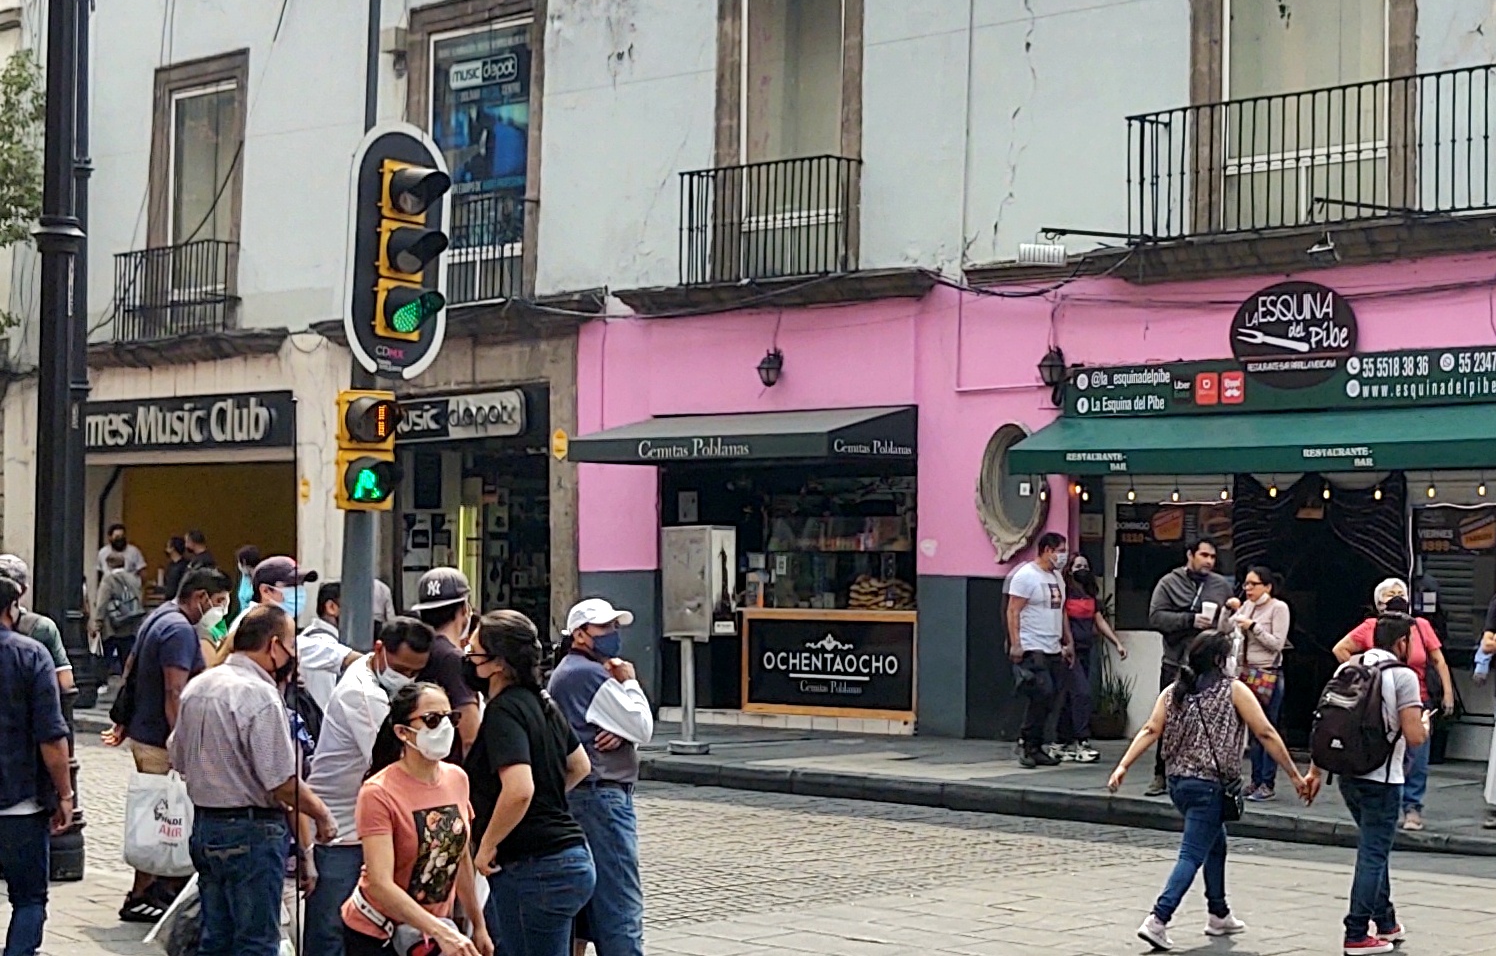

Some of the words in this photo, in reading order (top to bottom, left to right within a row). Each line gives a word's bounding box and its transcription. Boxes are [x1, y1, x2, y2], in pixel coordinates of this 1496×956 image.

[452, 67, 480, 83] music
[483, 57, 515, 79] depot
[1245, 312, 1258, 326] LA
[1258, 292, 1333, 322] ESQUINA
[1288, 322, 1306, 338] del
[1308, 321, 1349, 348] Pibe
[1362, 358, 1375, 378] 55
[1376, 357, 1400, 377] 5518
[1402, 357, 1414, 376] 38
[1416, 355, 1429, 375] 36
[1458, 353, 1471, 373] 55
[1091, 368, 1171, 389] @la_esquinadelpibe
[1174, 380, 1191, 390] Uber
[1091, 397, 1100, 412] La
[1102, 395, 1132, 413] Esquina
[1134, 394, 1146, 410] del
[1148, 394, 1165, 410] Pibe
[85, 413, 131, 446] mes
[135, 403, 207, 444] Music
[210, 397, 269, 442] Club
[396, 404, 442, 433] usic
[449, 400, 514, 434] depot
[638, 440, 689, 458] Cemitas
[692, 437, 749, 457] Poblanas
[834, 439, 871, 454] Cemitas
[873, 440, 912, 455] Poblanas
[1354, 458, 1373, 466] BAR
[763, 652, 898, 674] OCHENTAOCHO
